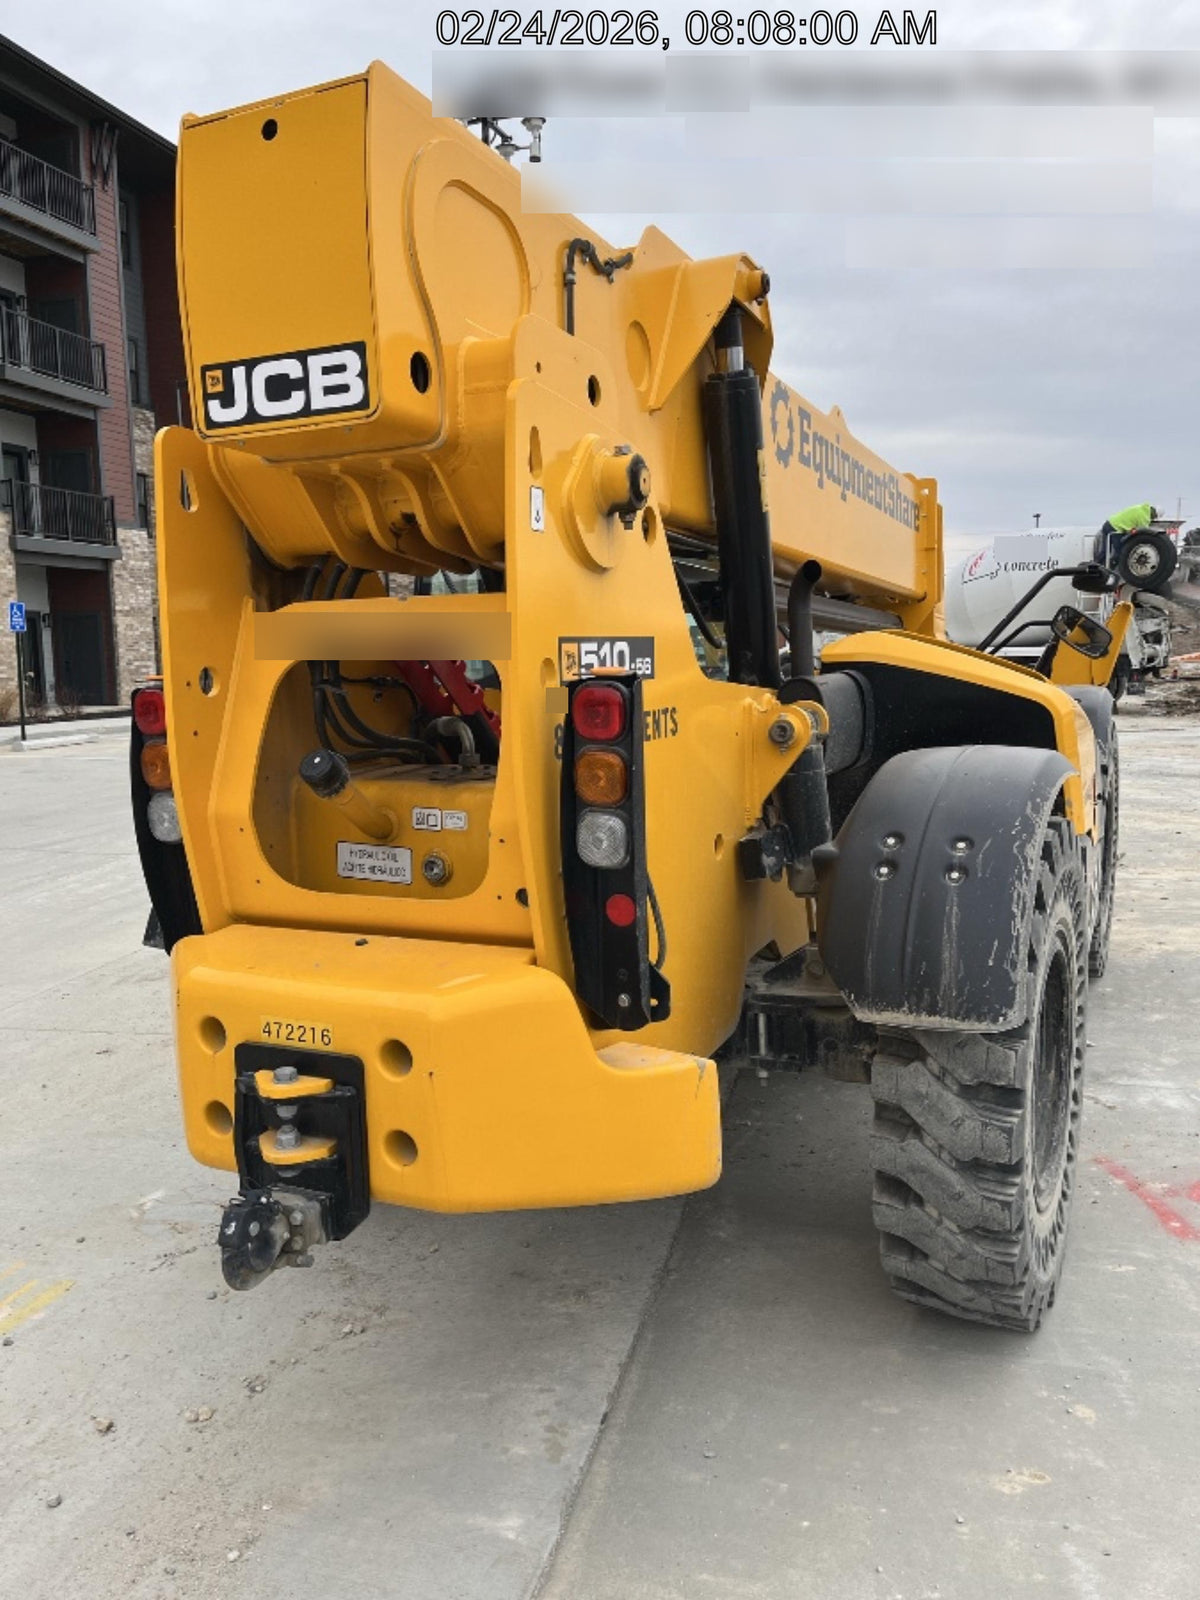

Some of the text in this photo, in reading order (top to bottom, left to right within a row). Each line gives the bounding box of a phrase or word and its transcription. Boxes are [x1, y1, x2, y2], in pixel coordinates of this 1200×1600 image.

[207, 349, 365, 423] JCB
[798, 405, 920, 532] EquipmentShare
[262, 1021, 332, 1046] 472216
